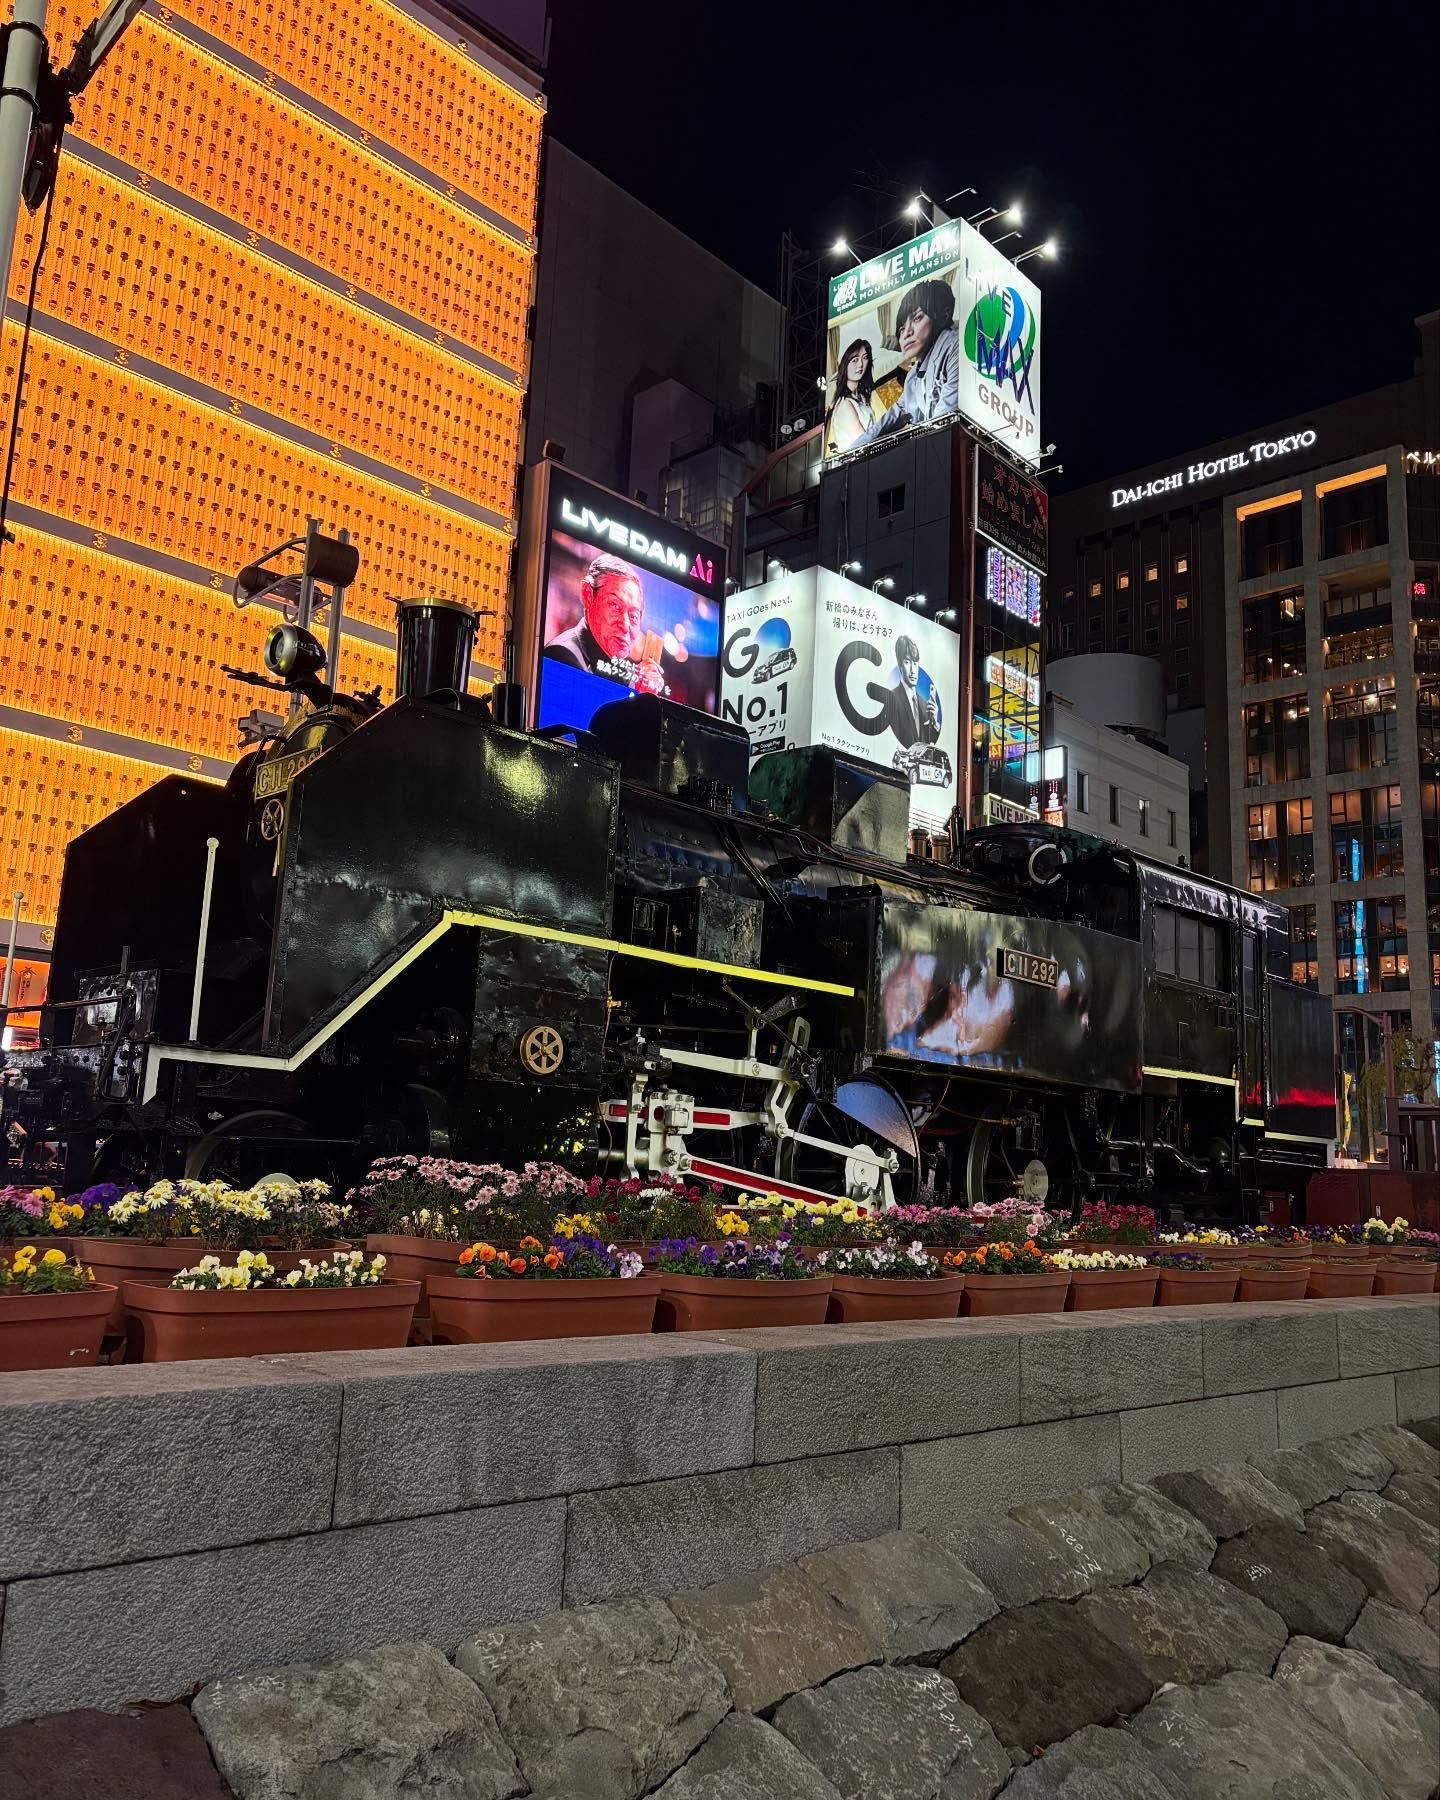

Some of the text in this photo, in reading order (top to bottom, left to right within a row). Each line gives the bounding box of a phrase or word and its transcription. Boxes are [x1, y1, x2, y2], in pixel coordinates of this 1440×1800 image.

[859, 252, 904, 291] LVE
[859, 248, 959, 301] MONTHLY MANSION
[978, 383, 1035, 438] GROUP
[726, 607, 745, 623] TAXI
[746, 604, 769, 617] GOes
[722, 681, 788, 725] No.1
[1031, 960, 1055, 984] 292
